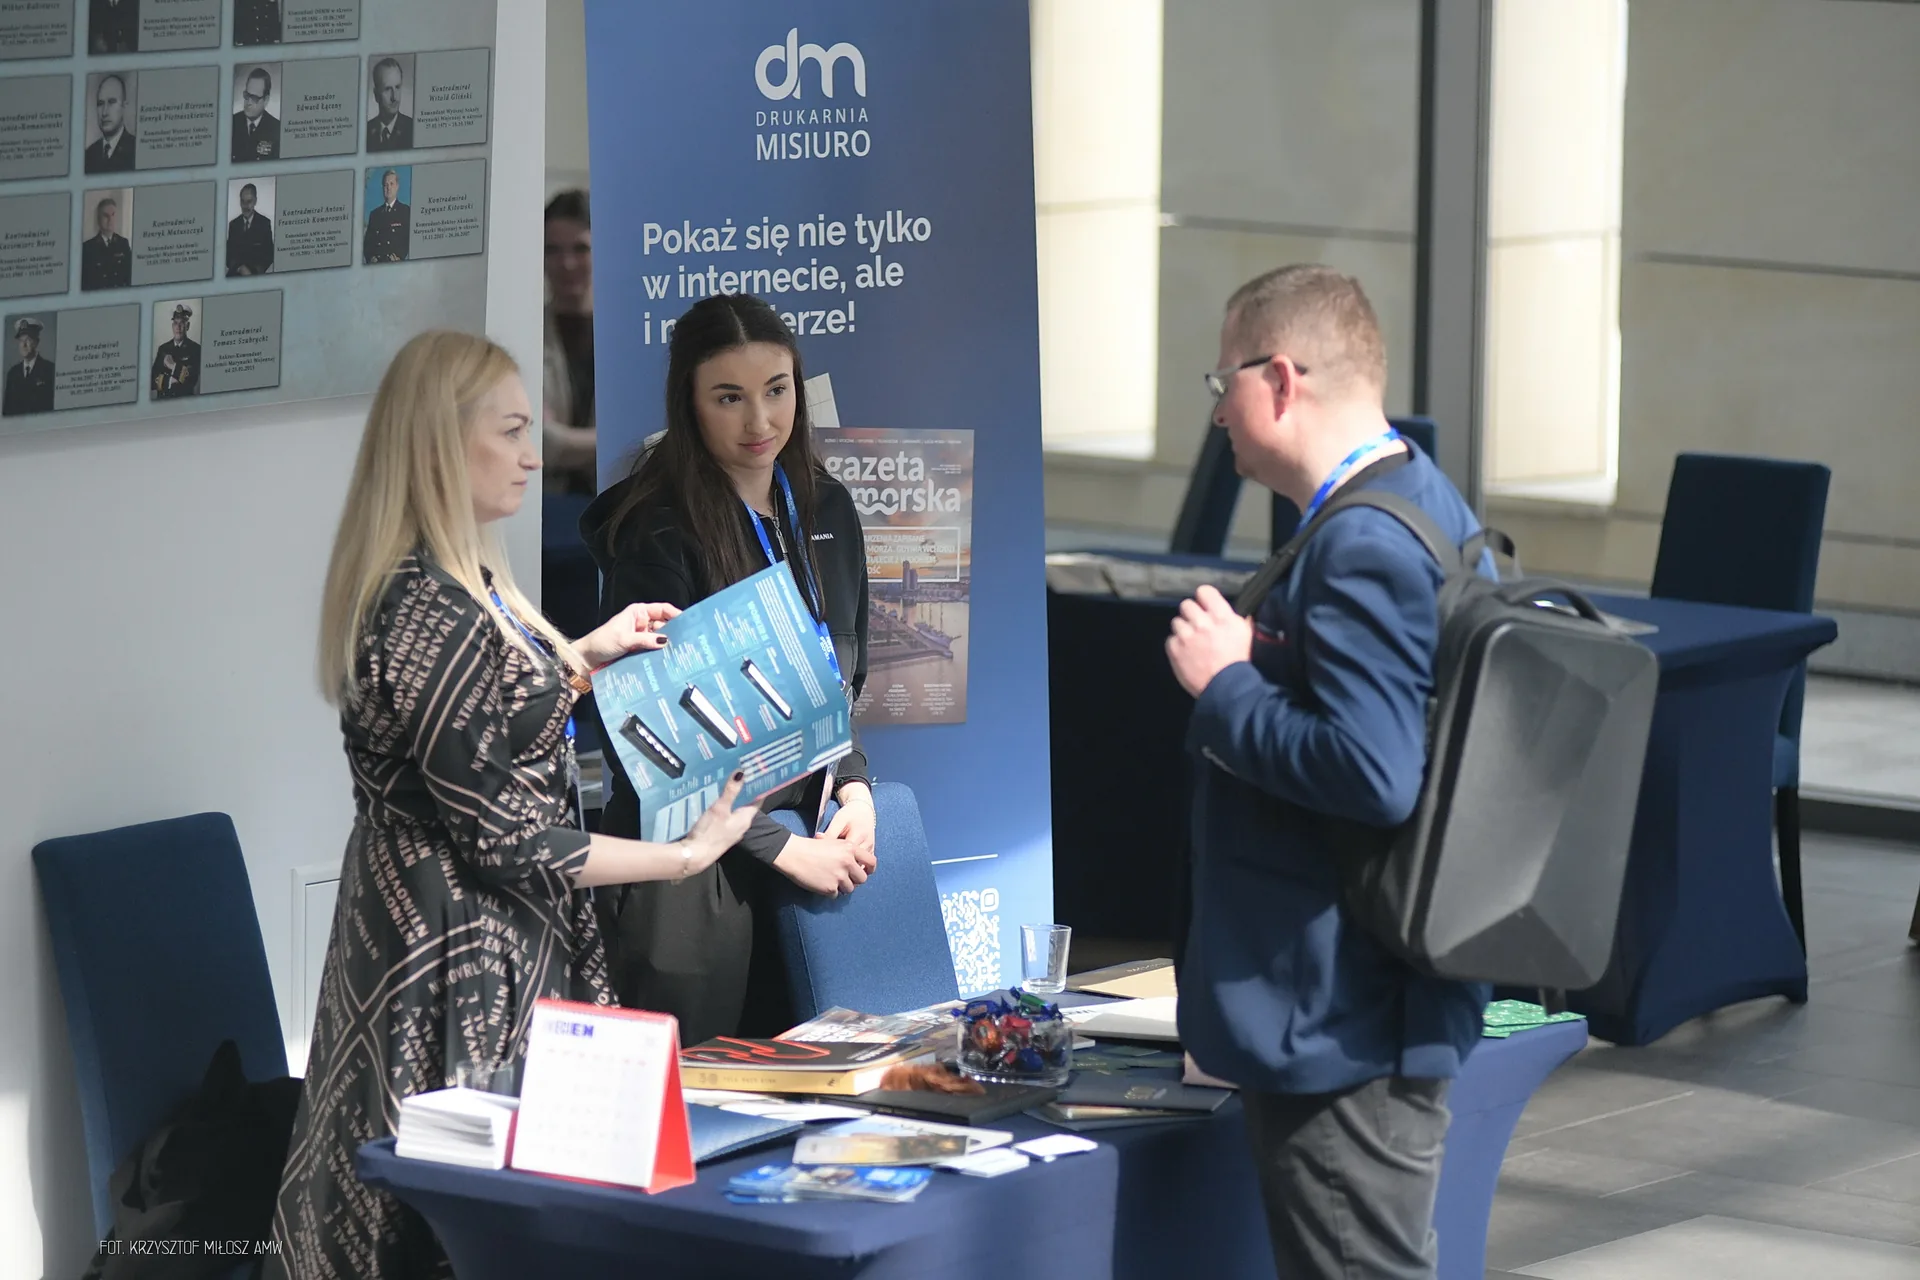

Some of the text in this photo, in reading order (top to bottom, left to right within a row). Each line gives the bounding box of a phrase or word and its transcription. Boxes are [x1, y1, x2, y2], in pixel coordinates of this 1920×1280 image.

[756, 108, 869, 126] DRUKARNIA
[757, 130, 871, 161] MISIURO
[643, 210, 932, 256] Pokaż się nie tylko
[642, 255, 904, 300] w internecie, ale
[644, 312, 650, 345] i
[824, 451, 925, 481] gazeta
